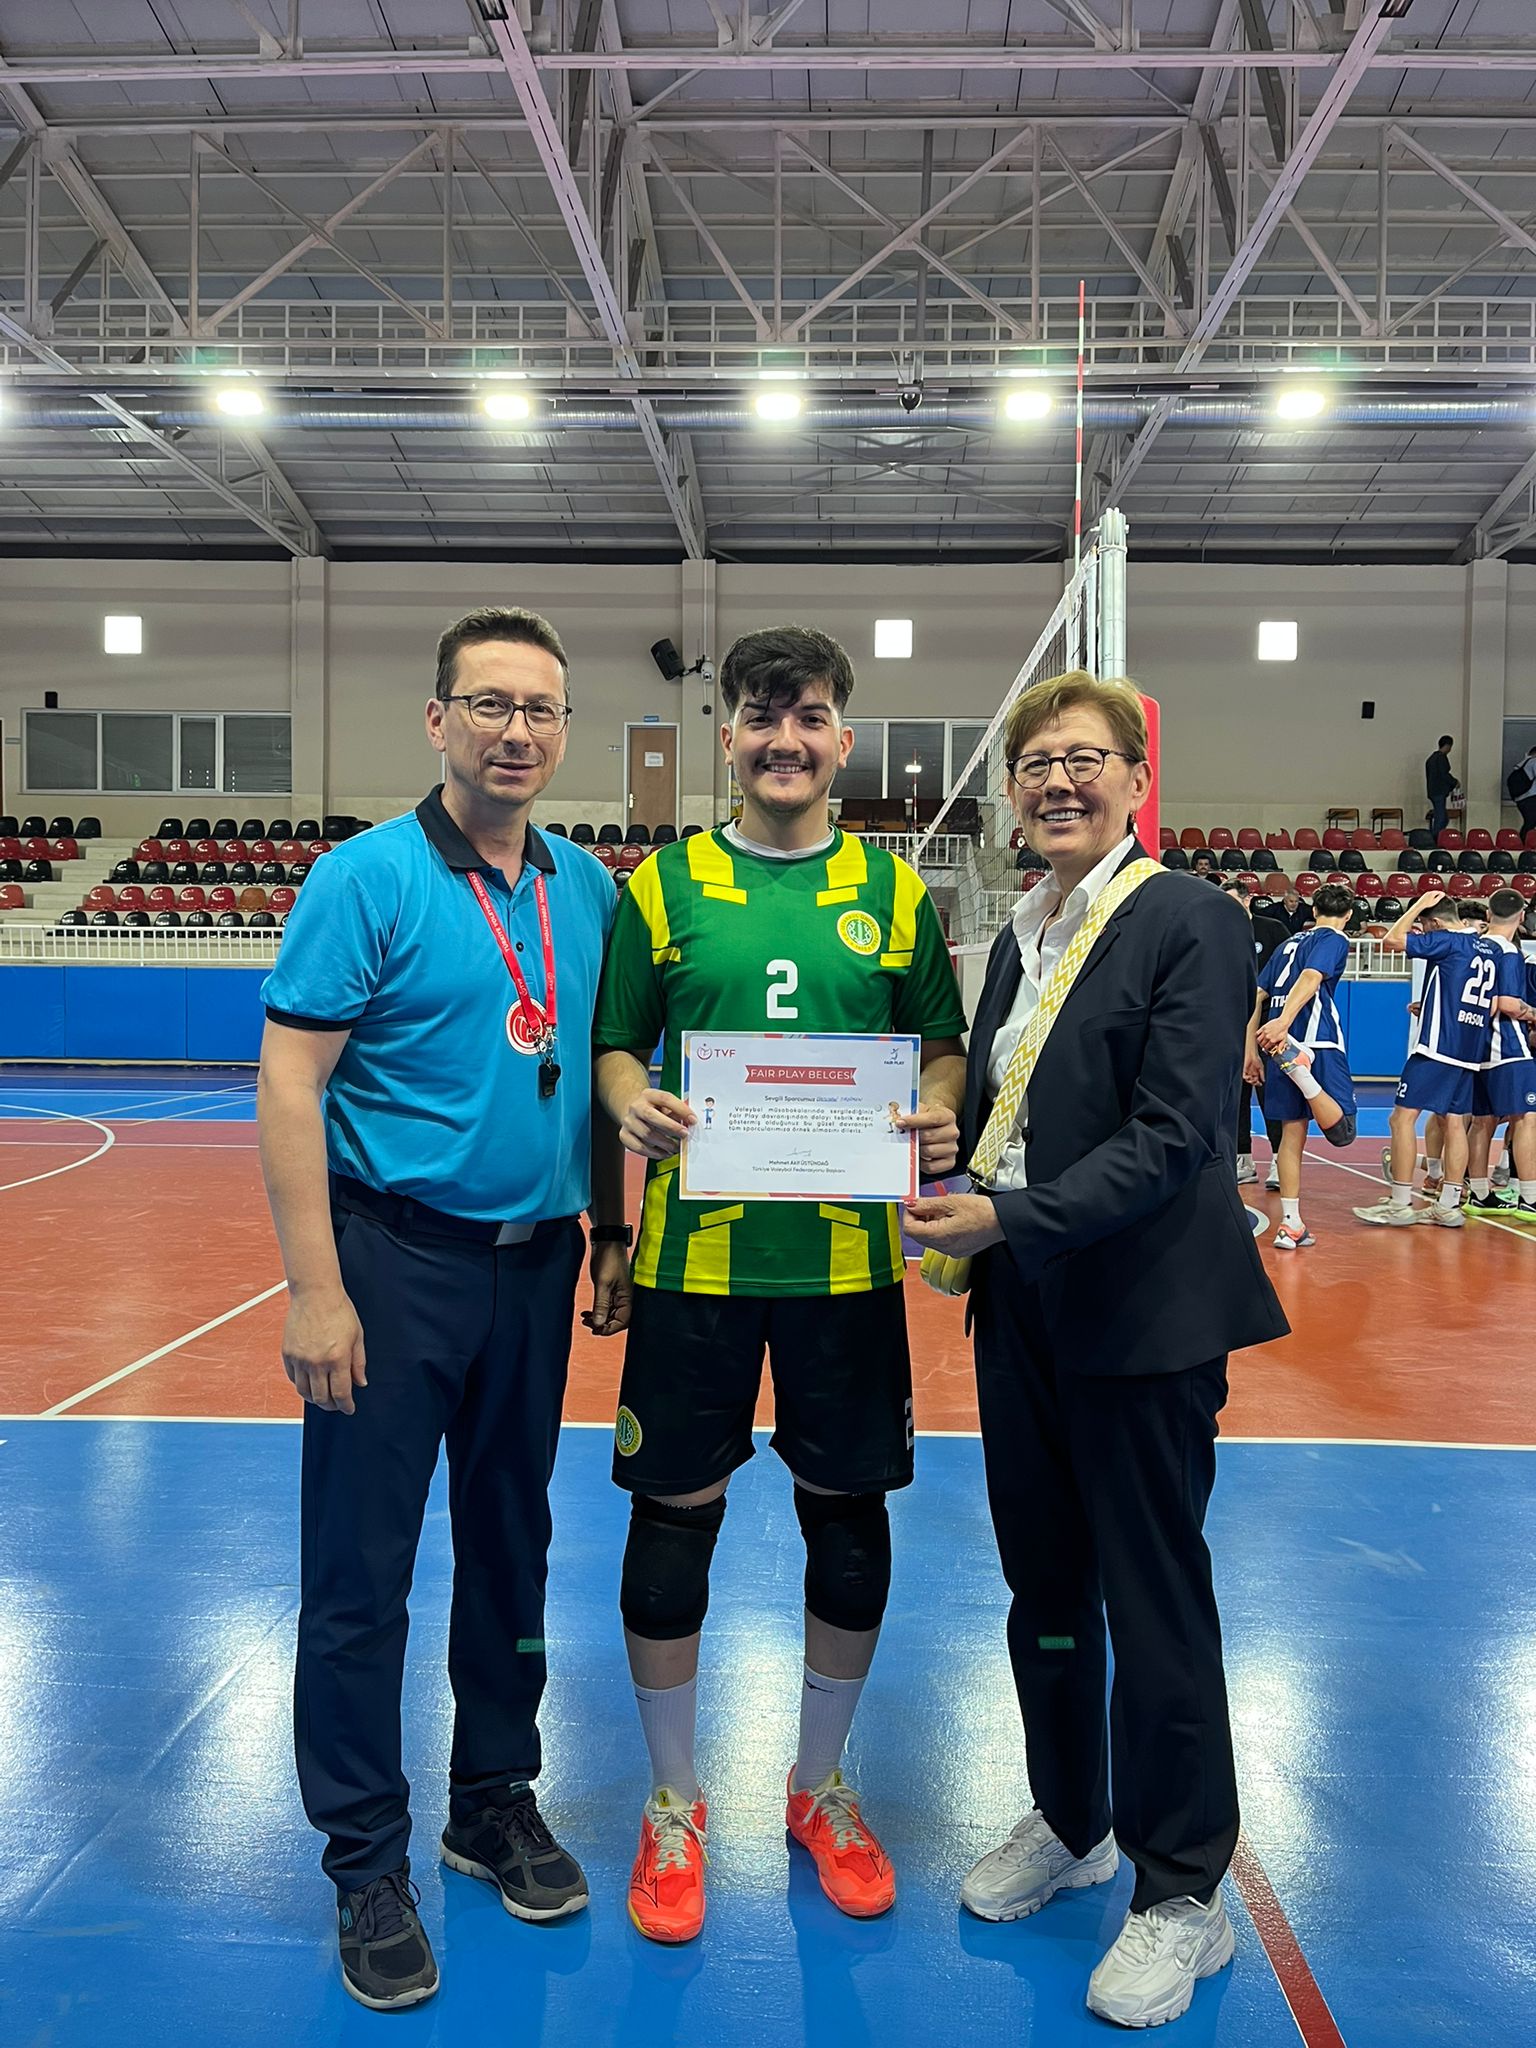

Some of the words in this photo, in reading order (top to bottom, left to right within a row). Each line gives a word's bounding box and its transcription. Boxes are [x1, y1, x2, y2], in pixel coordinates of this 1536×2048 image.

[482, 897, 498, 927] VOLEYBOL
[1274, 942, 1300, 987] 7
[1460, 956, 1496, 1008] 22
[766, 959, 798, 1018] 2
[714, 1049, 736, 1058] TVF
[750, 1069, 775, 1078] FAIR
[778, 1070, 805, 1078] PLAY
